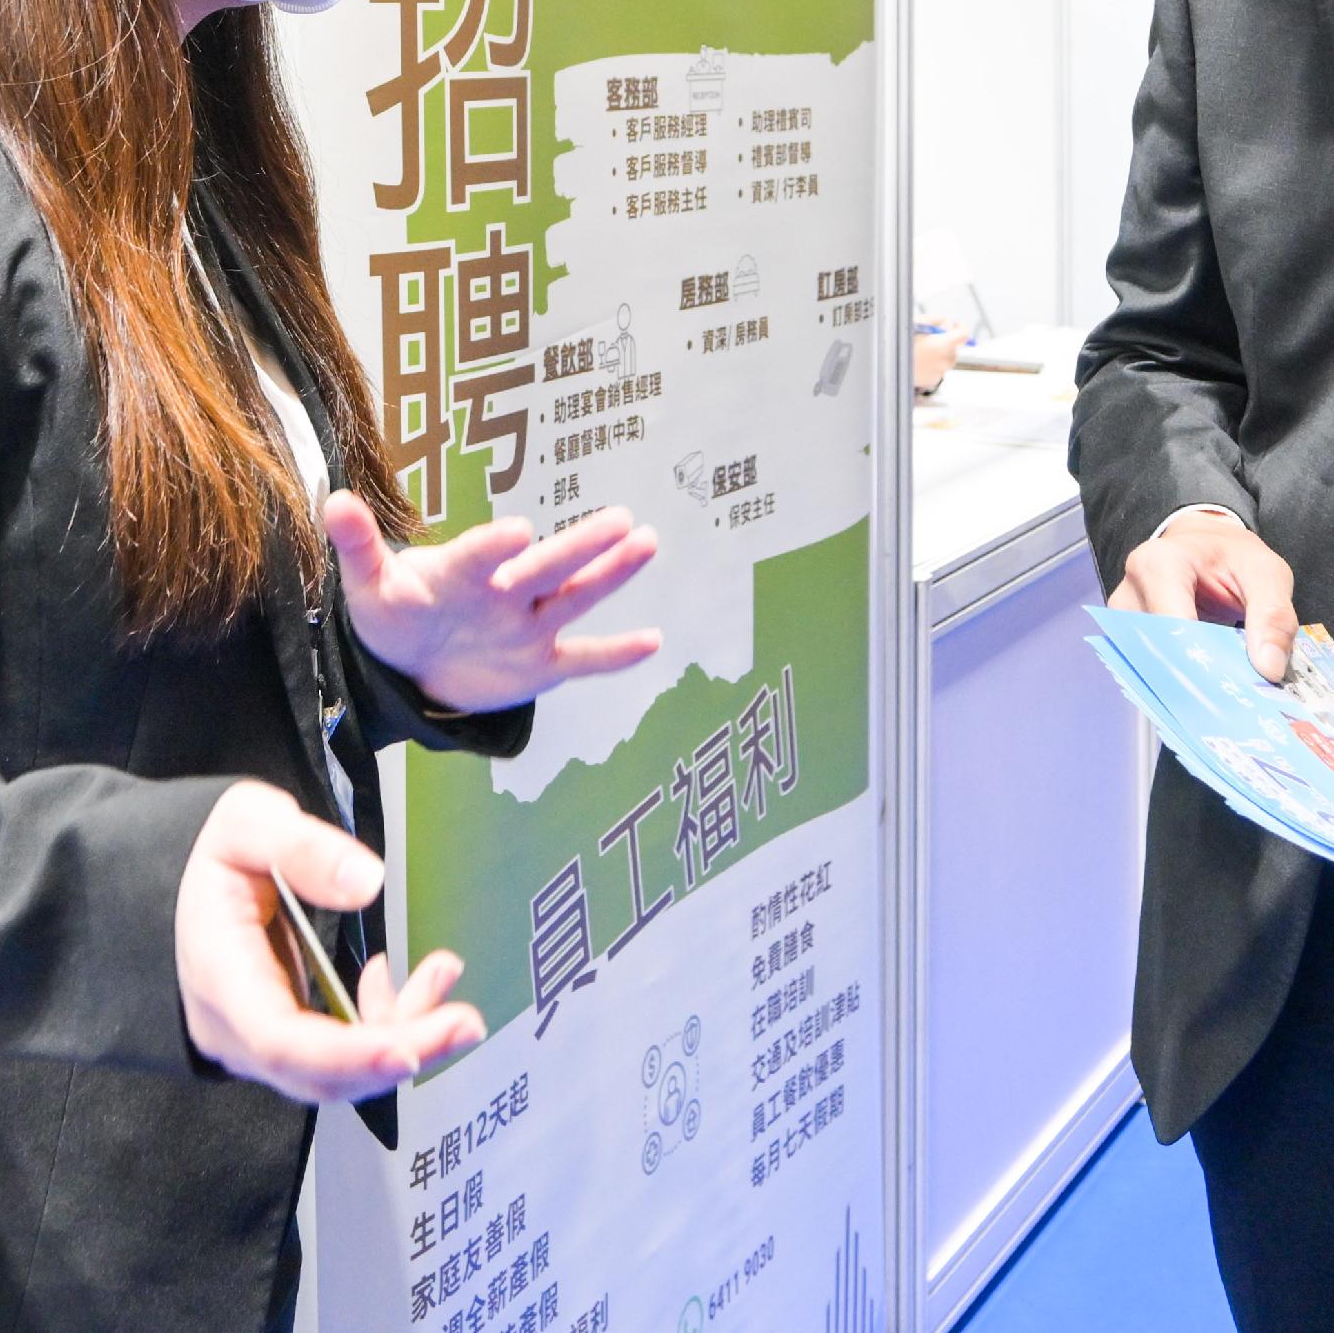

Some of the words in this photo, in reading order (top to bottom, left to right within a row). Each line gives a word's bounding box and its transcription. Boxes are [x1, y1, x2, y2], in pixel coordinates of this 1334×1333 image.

[606, 76, 659, 109] 客務部
[626, 114, 707, 143] 客戶服務經理
[751, 107, 812, 133] 助理禮賓司
[626, 149, 707, 181] 客戶服務督導
[626, 186, 707, 220] 客戶服務主任
[679, 271, 730, 308] 房務部
[817, 266, 860, 301] 訂房部
[543, 337, 594, 380] 餐飲部
[554, 371, 662, 425] 助理宴會銷售經理
[554, 415, 645, 466] 餐廳督導(中菜)
[554, 472, 580, 507] 部長
[712, 454, 758, 498] 保安部
[729, 492, 775, 530] 保安主任
[529, 664, 800, 1041] 員工福利
[751, 965, 815, 1042] 在職培訓
[751, 980, 861, 1092] 交通及培訓津貼
[409, 1071, 530, 1193] 年假12天起
[750, 1083, 845, 1188] 每月七天假期
[410, 1169, 484, 1262] 生日假
[410, 1193, 526, 1323] 家庭友善假
[708, 1274, 741, 1321] 6411
